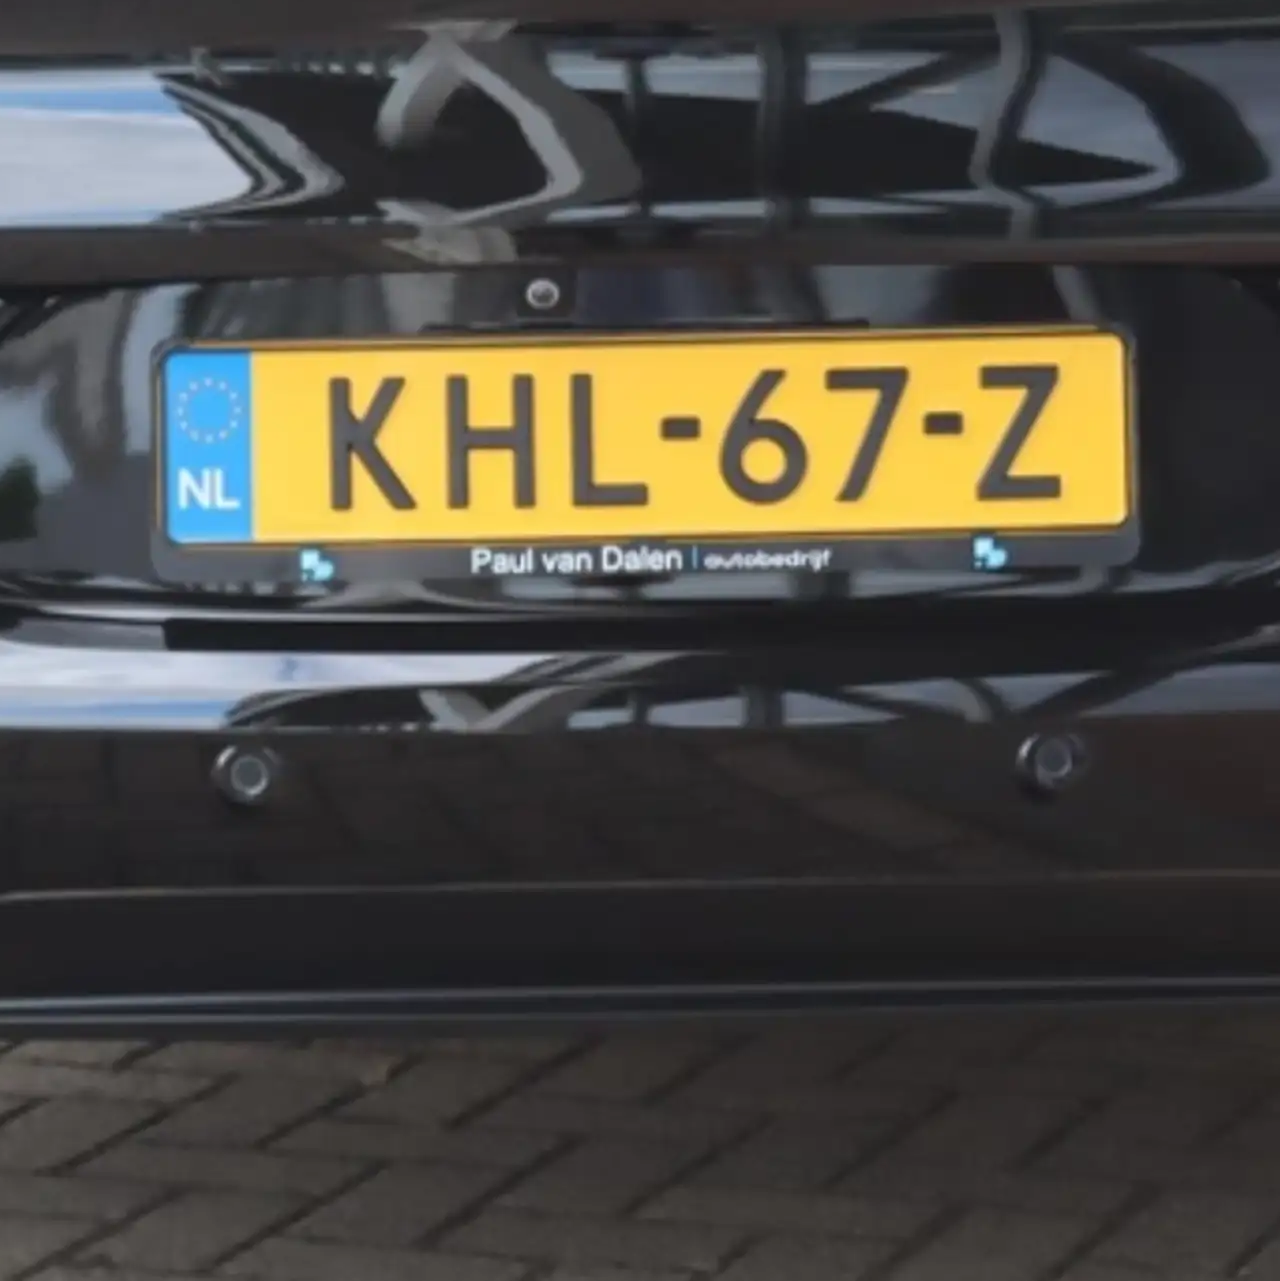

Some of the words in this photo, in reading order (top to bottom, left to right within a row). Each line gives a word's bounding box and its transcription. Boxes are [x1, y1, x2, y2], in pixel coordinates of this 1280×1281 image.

[328, 363, 1062, 512] KHL-67-Z
[178, 469, 240, 510] NL
[470, 546, 534, 575] Paul
[542, 551, 593, 574] van
[601, 545, 683, 573] Dalen
[703, 548, 833, 573] autobedrijf
